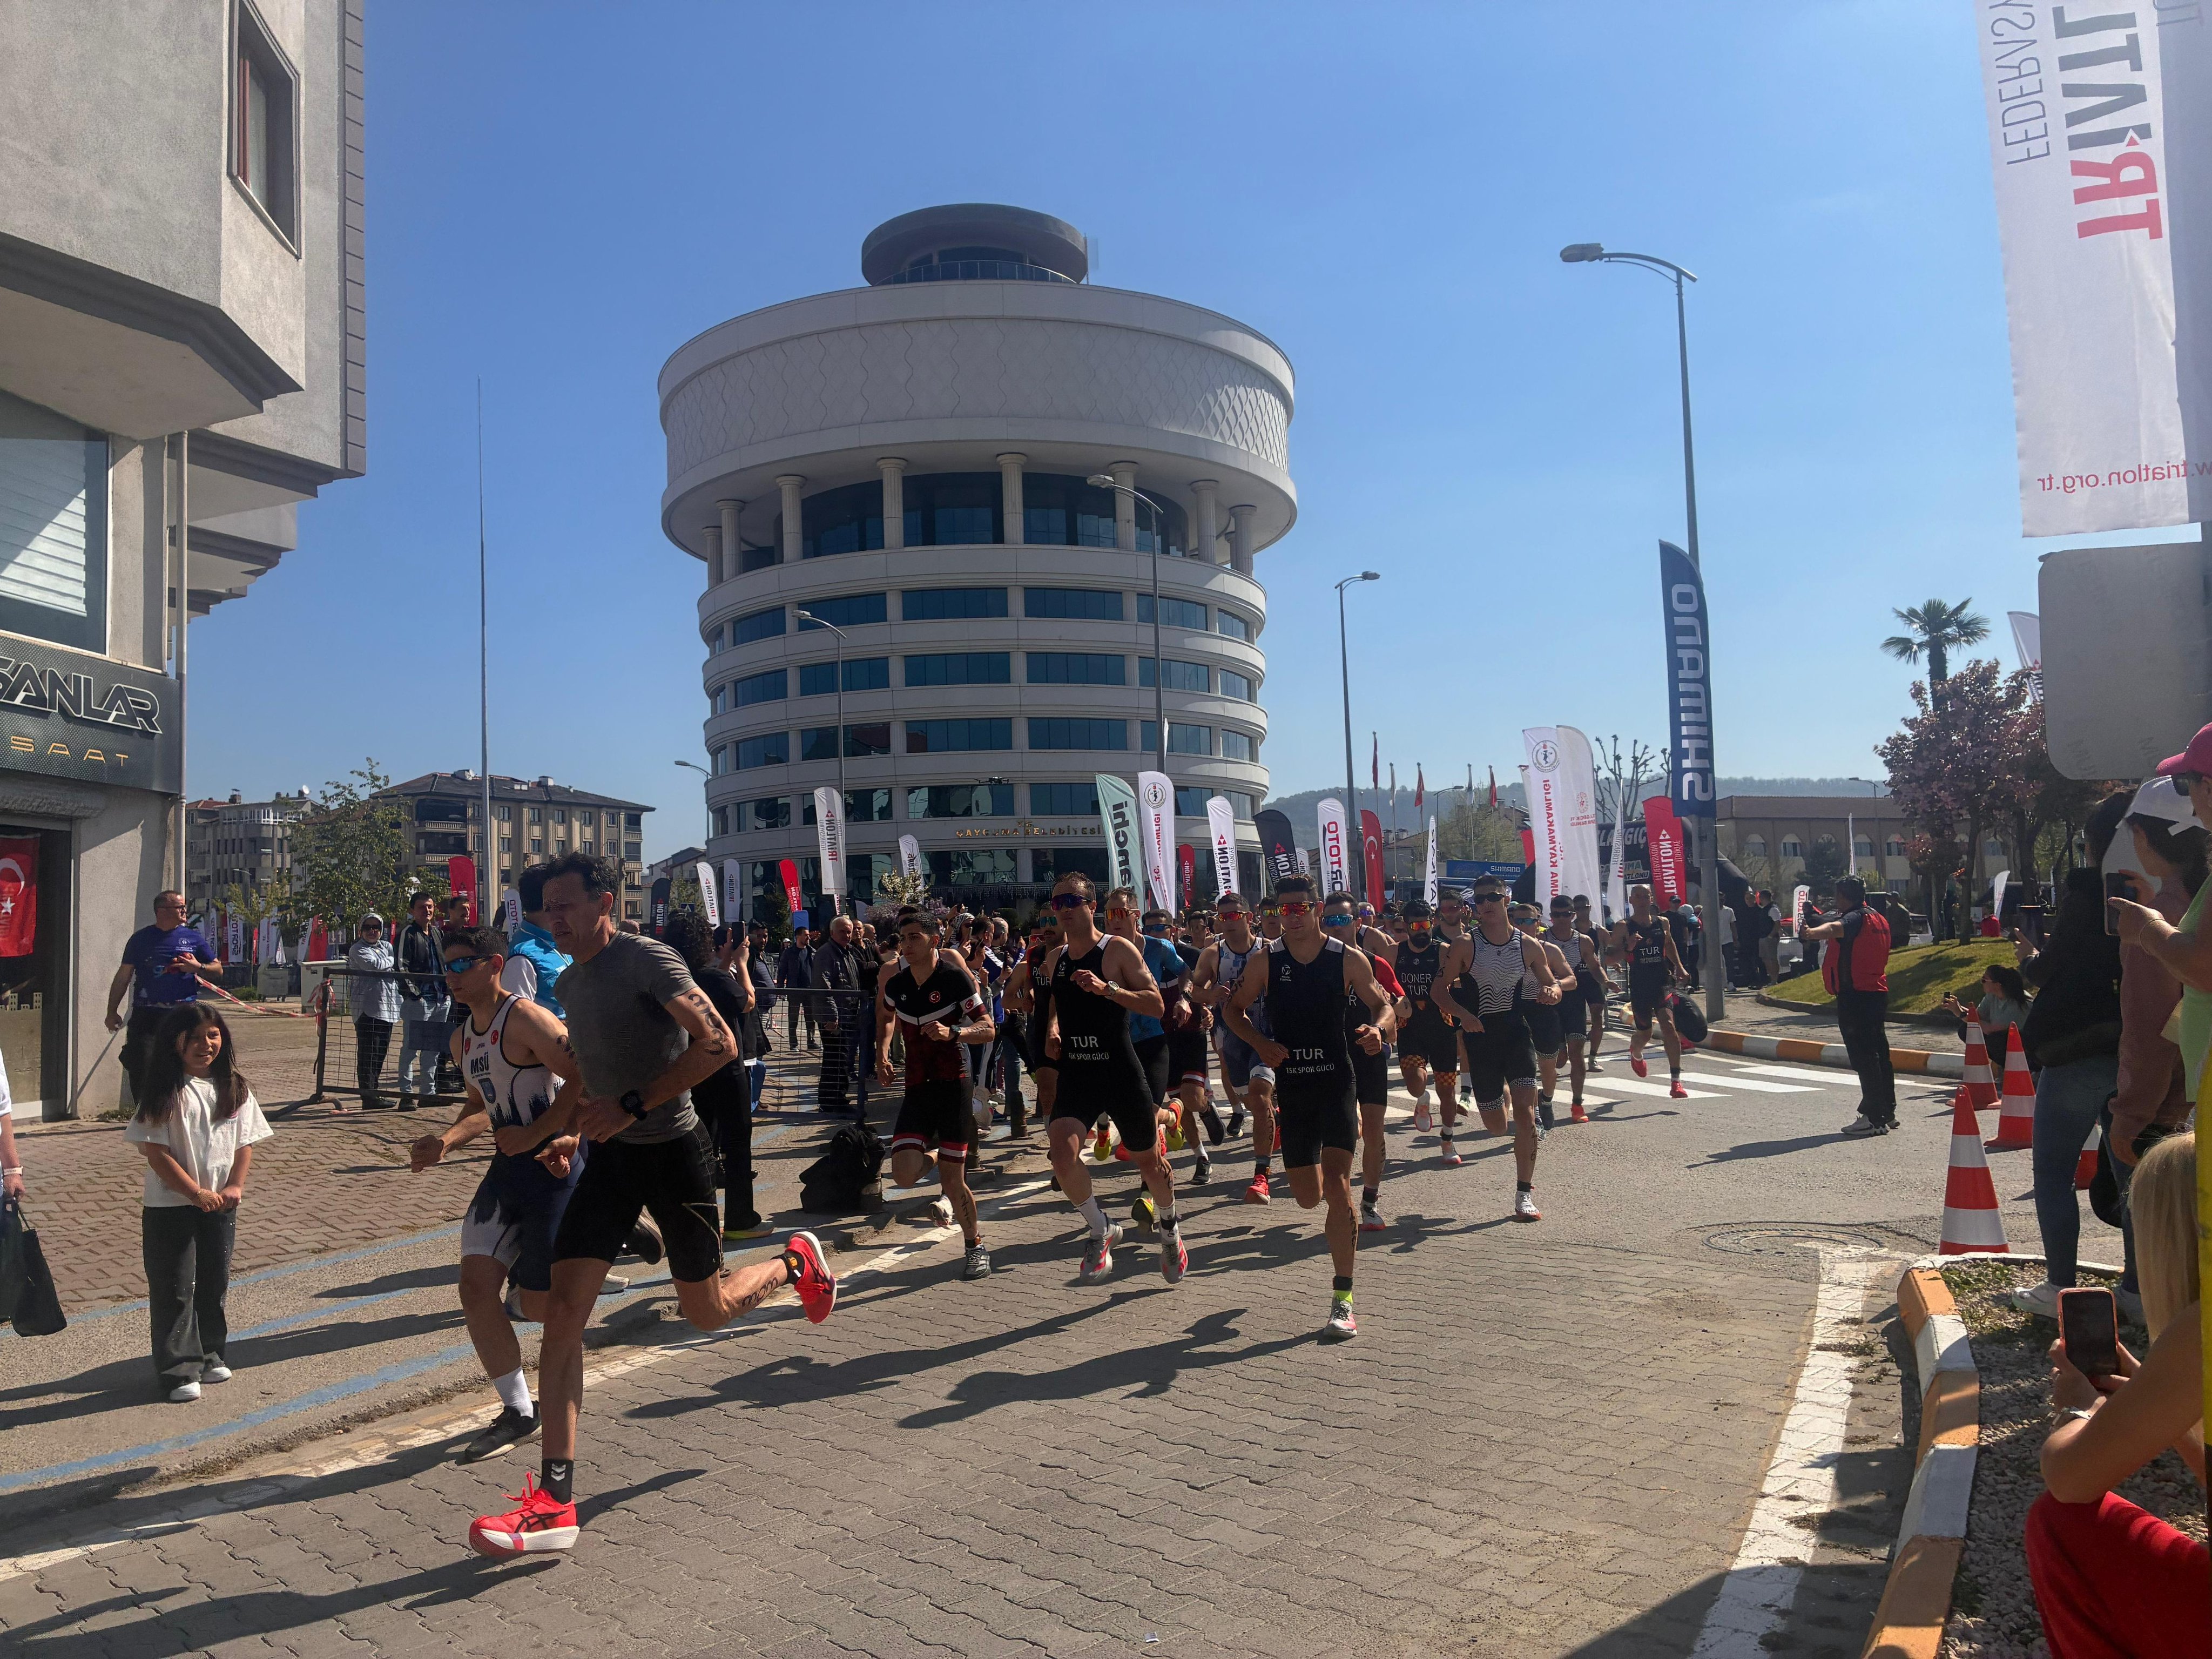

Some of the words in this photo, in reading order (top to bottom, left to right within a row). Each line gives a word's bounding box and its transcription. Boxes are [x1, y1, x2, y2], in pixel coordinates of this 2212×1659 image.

[10, 736, 129, 767] SAAT
[1640, 946, 1661, 956] TUR
[1407, 984, 1428, 995] TUR
[1070, 1036, 1099, 1048] TUR
[1293, 1048, 1324, 1060] TUR
[470, 1051, 489, 1075] MSÜ
